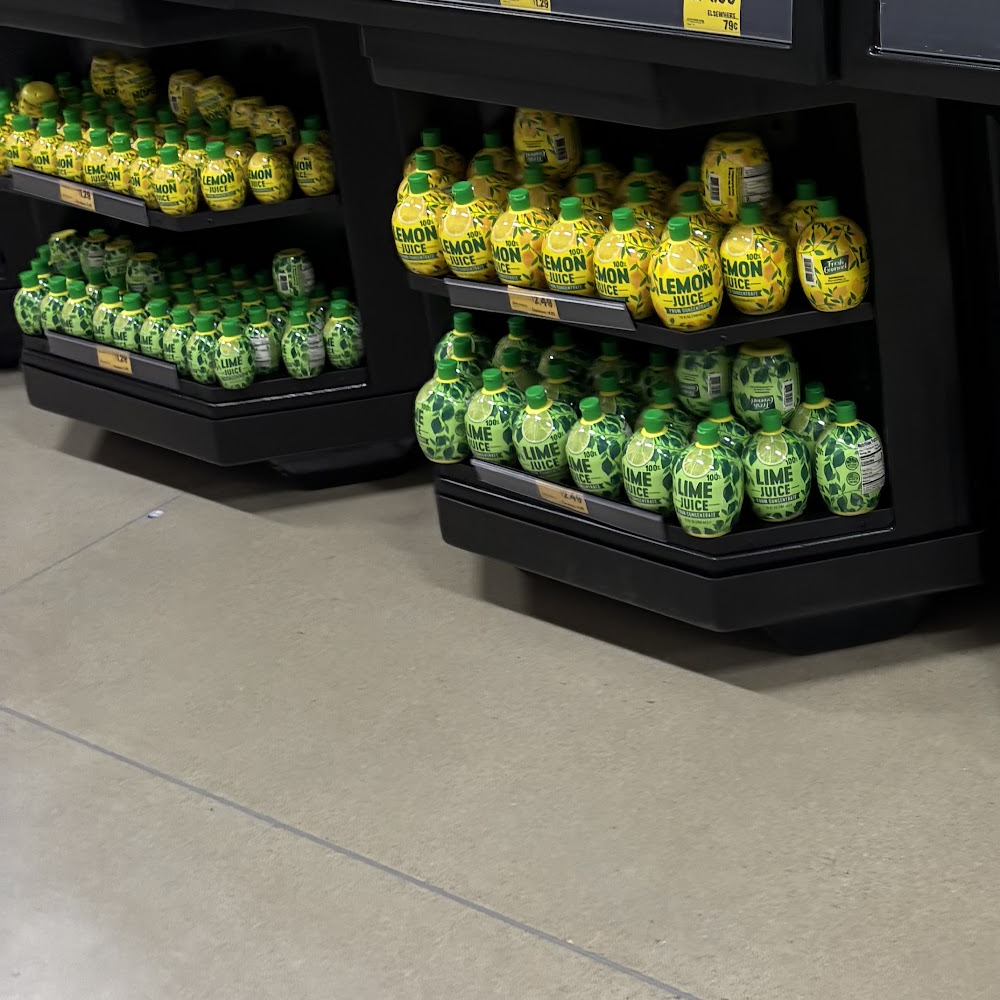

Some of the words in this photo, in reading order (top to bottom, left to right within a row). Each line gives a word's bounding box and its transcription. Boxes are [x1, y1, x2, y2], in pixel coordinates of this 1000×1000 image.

[203, 172, 235, 185] LEMON
[209, 185, 228, 193] JUICE
[395, 226, 437, 243] LEMON
[402, 244, 426, 254] JUICE
[443, 237, 486, 255] LEMON
[450, 256, 476, 265] JUICE
[544, 255, 587, 272] LEMON
[549, 273, 575, 284] JUICE
[659, 271, 713, 295] LEMON
[672, 292, 704, 306] JUICE
[221, 358, 243, 369] LIME
[224, 367, 243, 376] JUICE
[522, 441, 561, 461] LIME
[530, 459, 560, 471] JUICE
[623, 467, 652, 487] LIME
[756, 466, 793, 486] LIME
[677, 478, 713, 499] LIME
[760, 486, 791, 498] JUICE
[680, 499, 709, 511] JUICE
